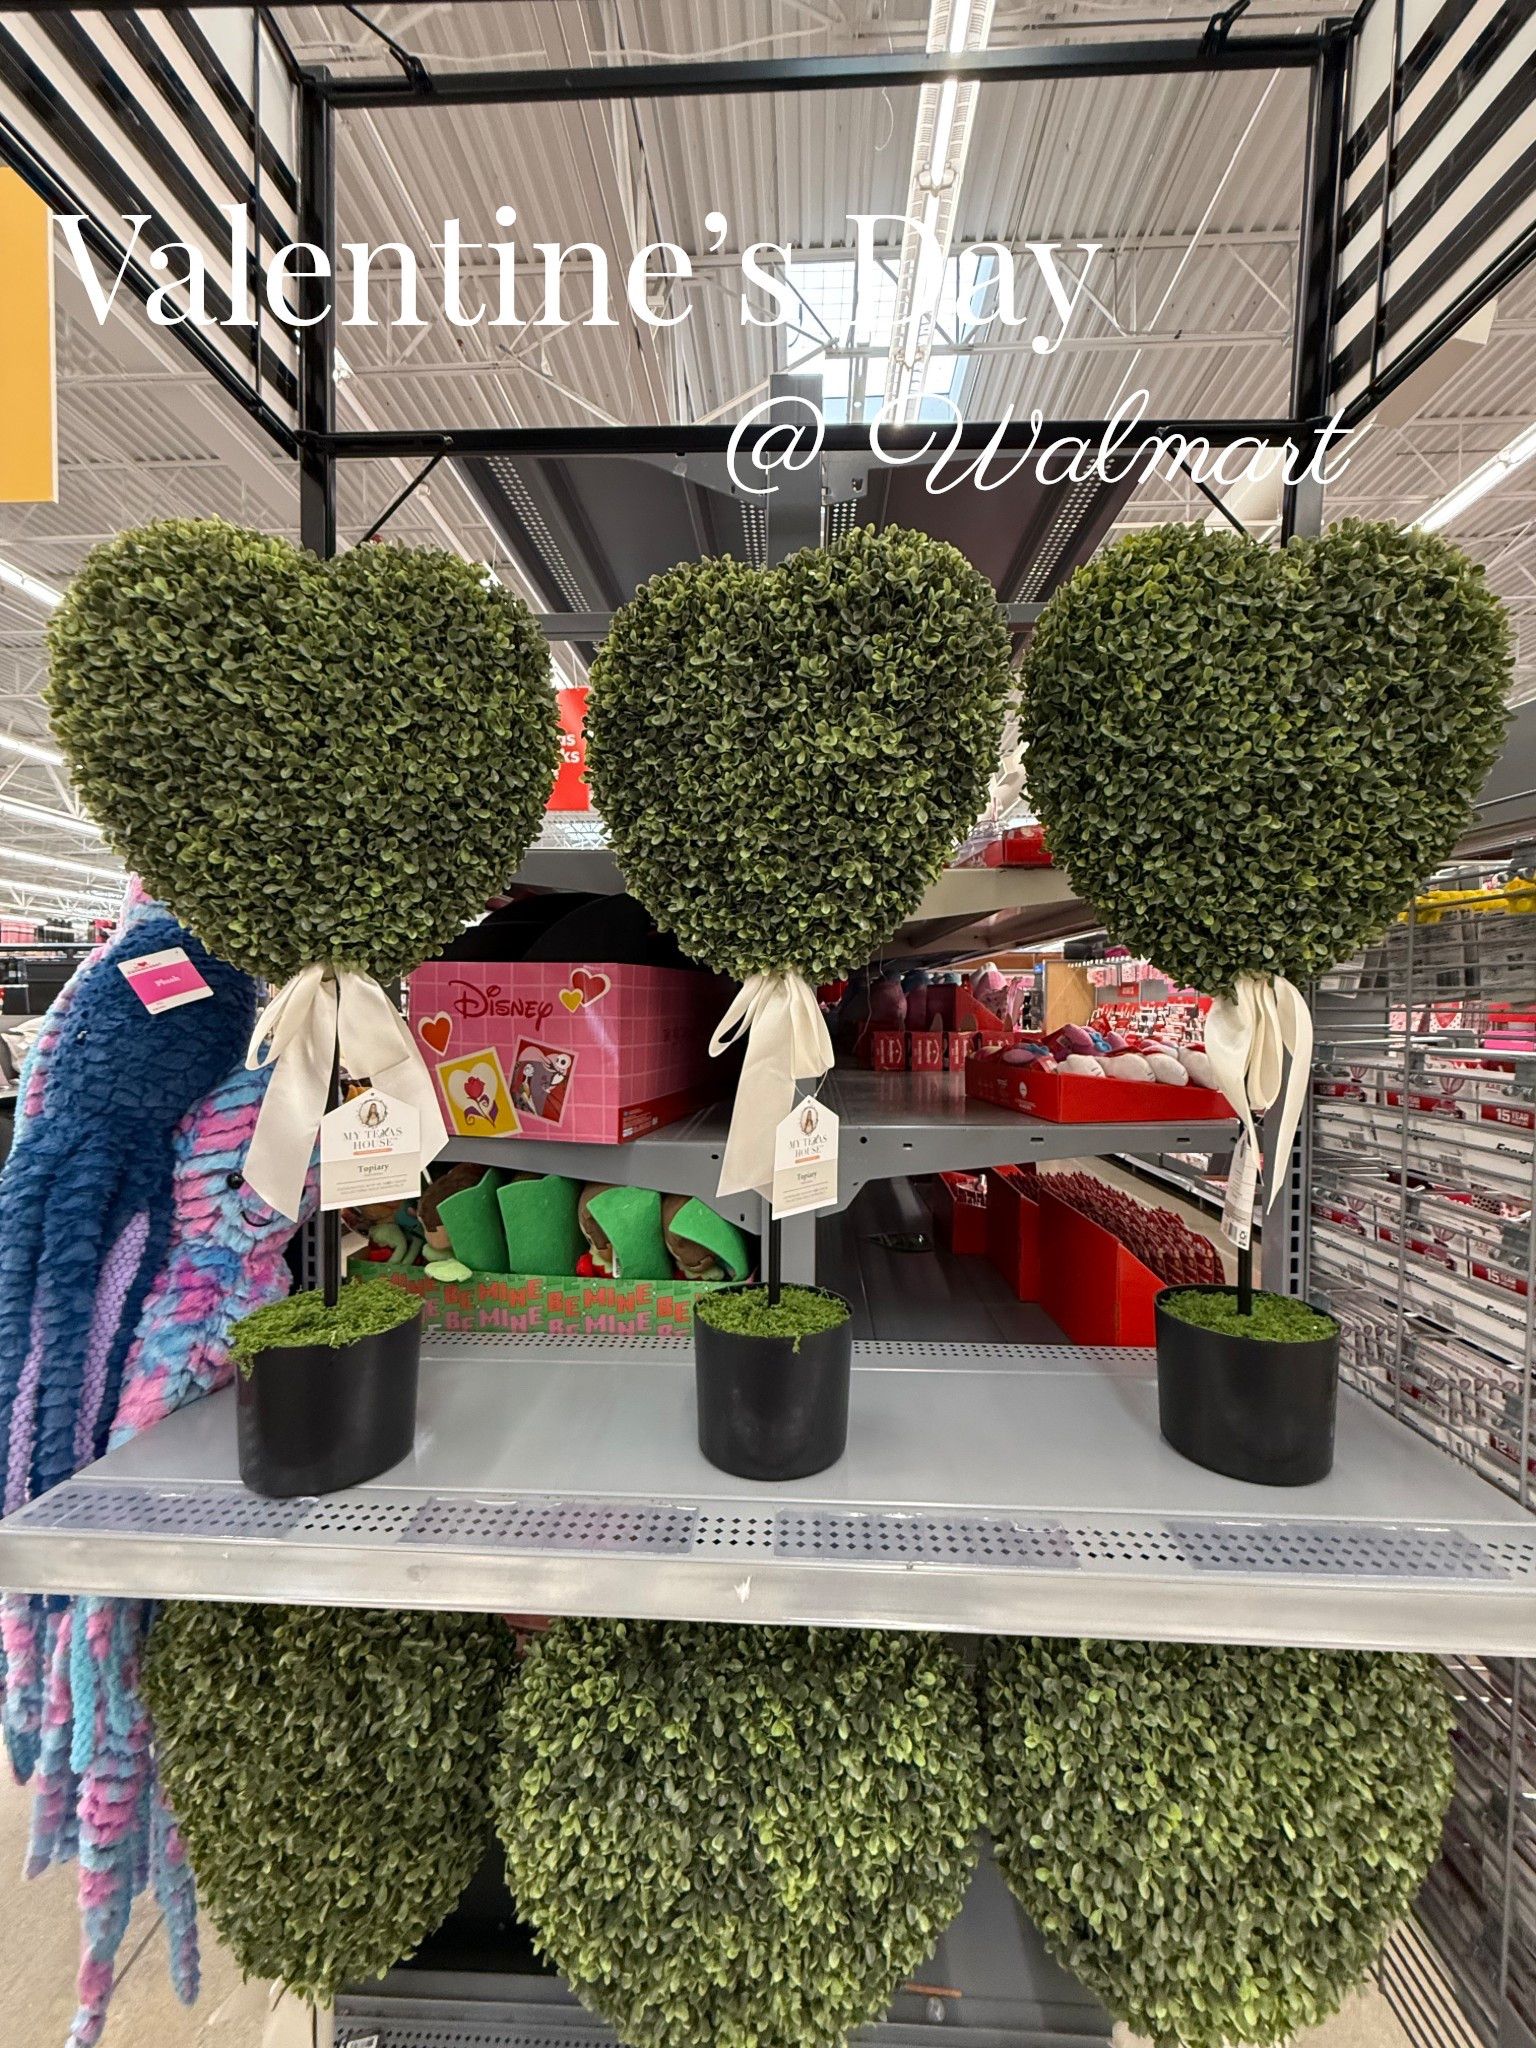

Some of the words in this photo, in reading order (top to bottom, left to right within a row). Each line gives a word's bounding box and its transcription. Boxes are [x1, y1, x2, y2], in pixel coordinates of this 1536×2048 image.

[155, 975, 181, 987] Plush
[1496, 1108, 1511, 1122] 15
[343, 1131, 359, 1141] MY
[364, 1127, 402, 1139] TEXAS
[353, 1138, 393, 1150] HOUSE
[358, 1164, 389, 1174] Topiary
[797, 1171, 817, 1181] Topiary
[1486, 1267, 1500, 1284] 15
[444, 1284, 475, 1310] BE
[478, 1279, 543, 1308] MINE
[547, 1291, 580, 1317] BE
[583, 1283, 652, 1314] MINE
[656, 1295, 691, 1322] BE
[479, 1305, 544, 1332] MINE
[584, 1310, 652, 1335] MINE
